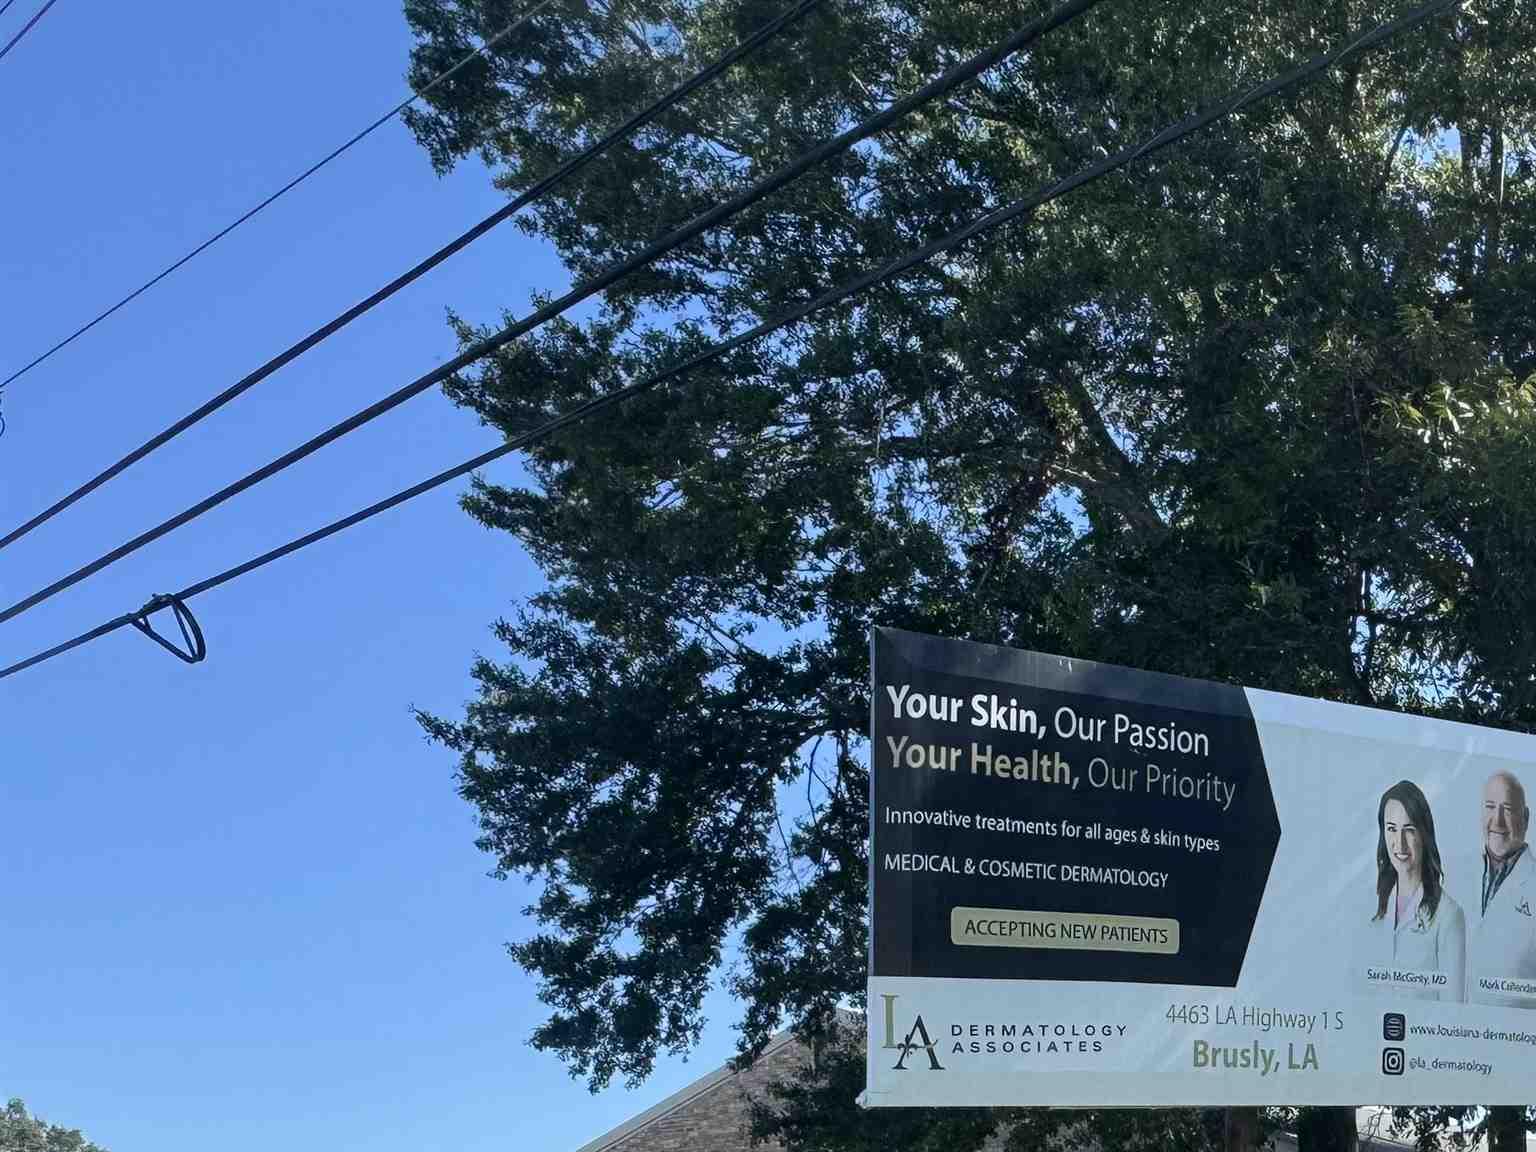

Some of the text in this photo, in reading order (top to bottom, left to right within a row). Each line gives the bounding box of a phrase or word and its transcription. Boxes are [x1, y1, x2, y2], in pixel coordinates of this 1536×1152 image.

[886, 684, 1209, 757] Your Skin, Our Passion
[886, 735, 1236, 811] Your Health, Our Priority
[885, 806, 1221, 853] Innovative treatments for all ages & skin types
[884, 853, 1169, 888] MEDICAL & COSMETIC DERMATOLOGY
[964, 919, 1169, 944] ACCEPTING NEW PATIENTS
[951, 1024, 1128, 1037] DERMATOLOGY
[1166, 1004, 1344, 1034] 4463 LA Highway 1 S
[952, 1040, 1104, 1054] ASSOCIATES
[1193, 1039, 1319, 1076] Brusly, LA
